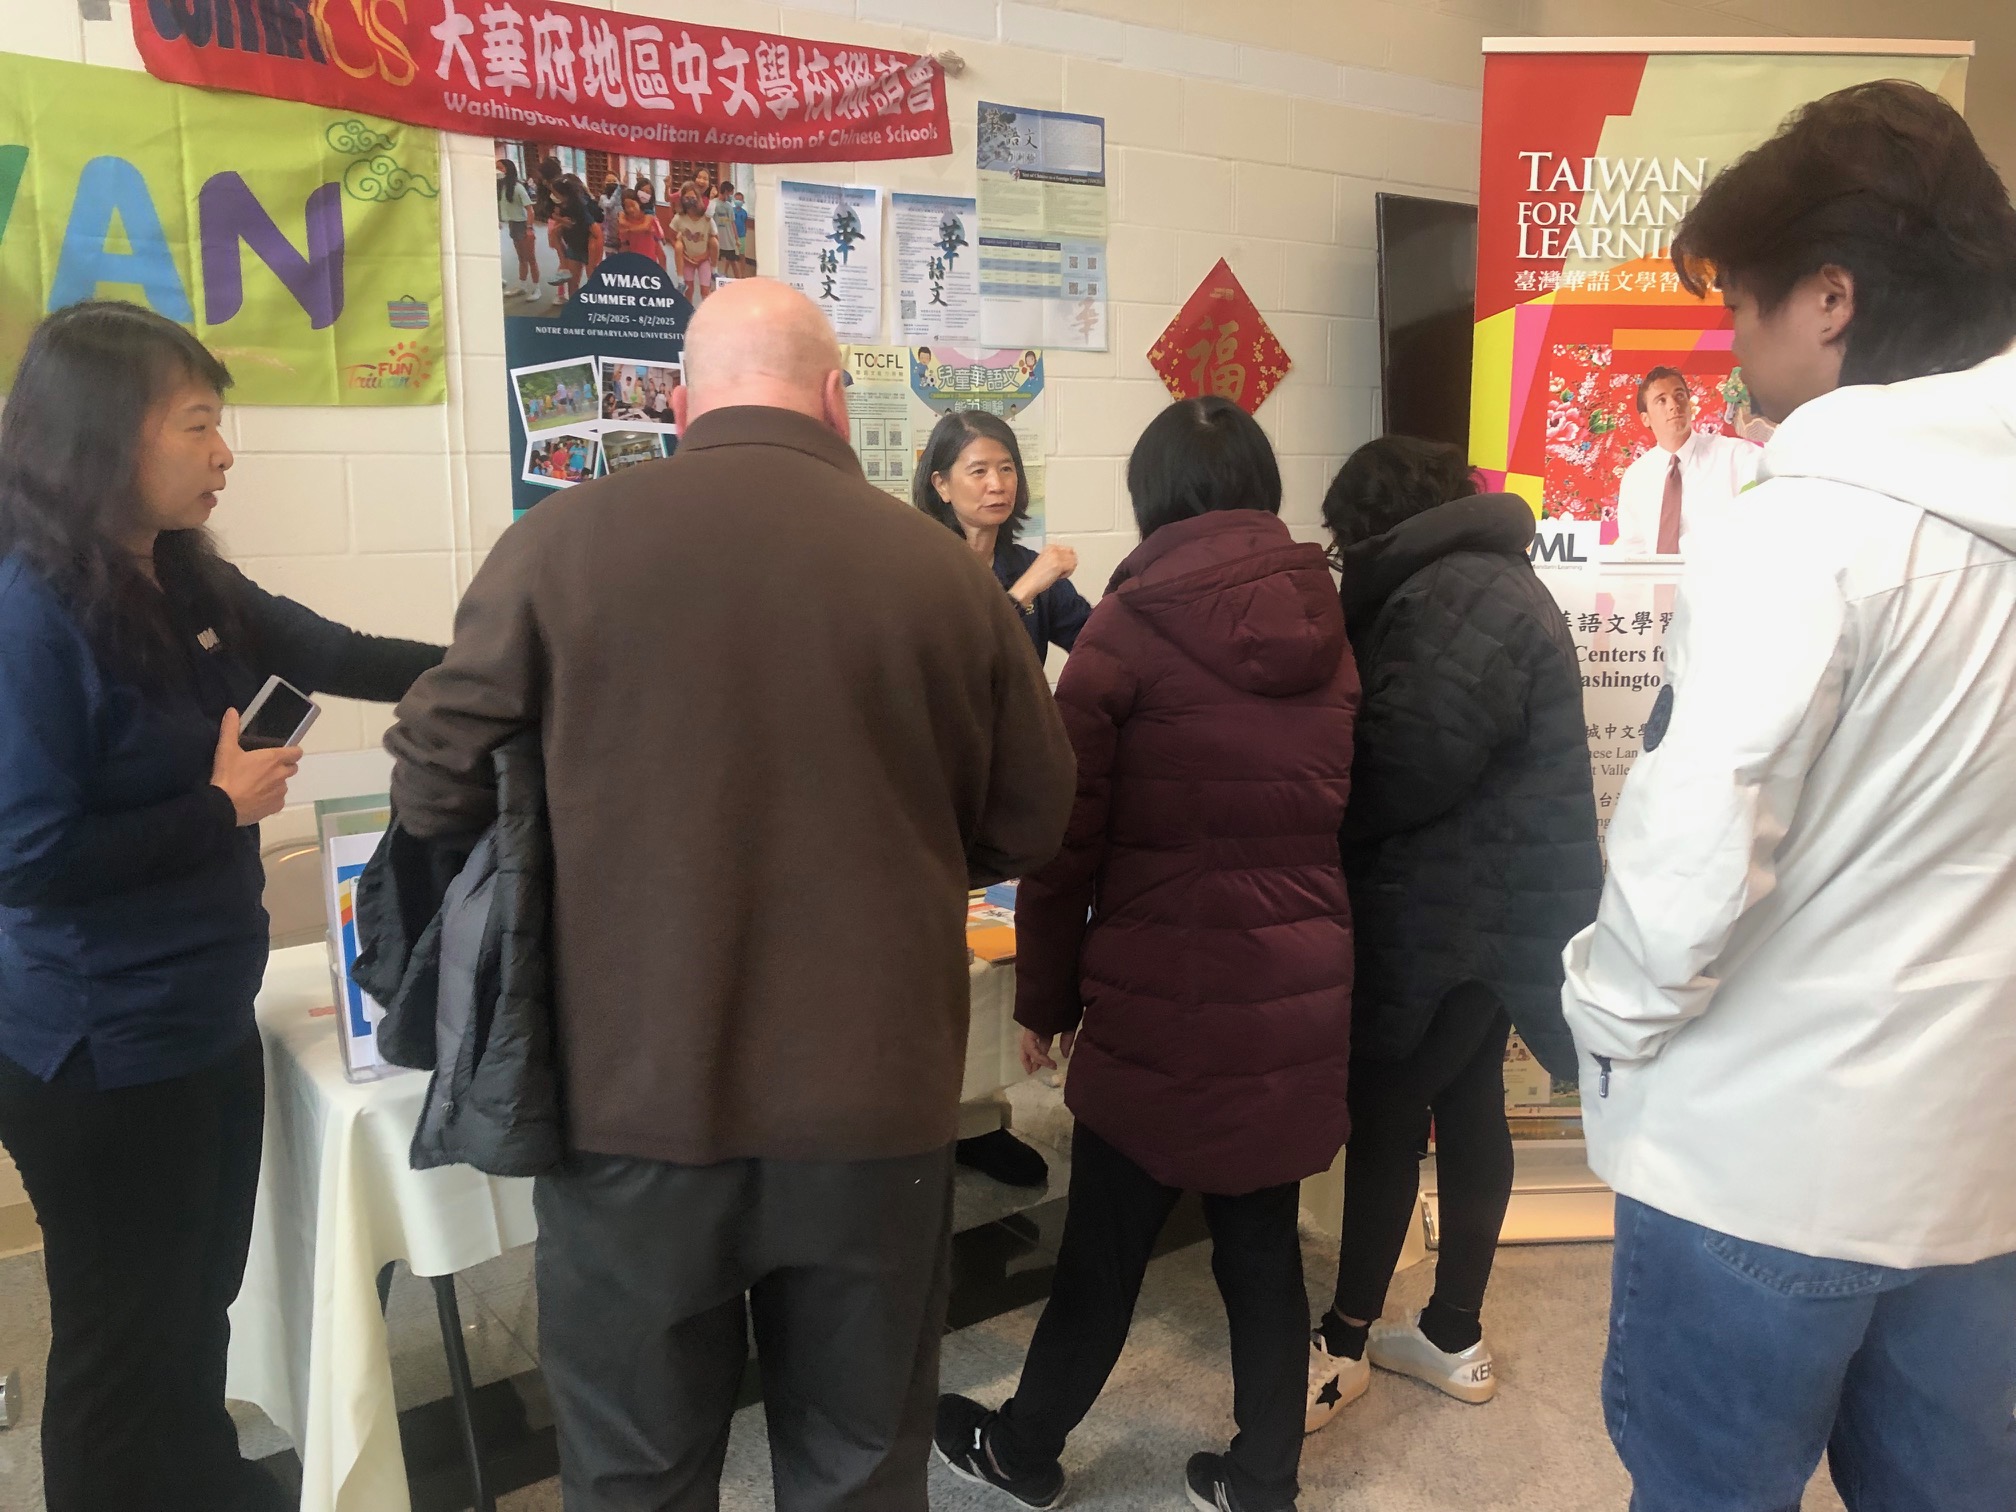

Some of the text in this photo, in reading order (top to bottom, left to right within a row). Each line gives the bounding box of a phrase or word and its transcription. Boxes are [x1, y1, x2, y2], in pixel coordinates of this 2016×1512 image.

[444, 92, 938, 150] Washington Metropolitan Association of Chinese Schools
[1518, 151, 1708, 193] TAIWAN
[1517, 188, 1702, 226] FOR MAN
[0, 144, 345, 330] AN
[818, 210, 866, 302] 華語文
[926, 218, 969, 308] 華語文
[601, 273, 661, 290] WMACS
[580, 292, 675, 308] SUMMER CAMP
[535, 326, 561, 335] NOTRE
[563, 328, 585, 336] DAME
[640, 331, 686, 341] UNIVERSITY
[587, 313, 630, 325] 7/26/2025
[638, 315, 676, 327] 8/2/2025
[378, 362, 413, 376] FUN
[854, 353, 904, 369] TOCFL
[1186, 315, 1246, 402] 福
[936, 364, 1021, 392] 兒童華語文
[1580, 671, 1661, 692] ashingto
